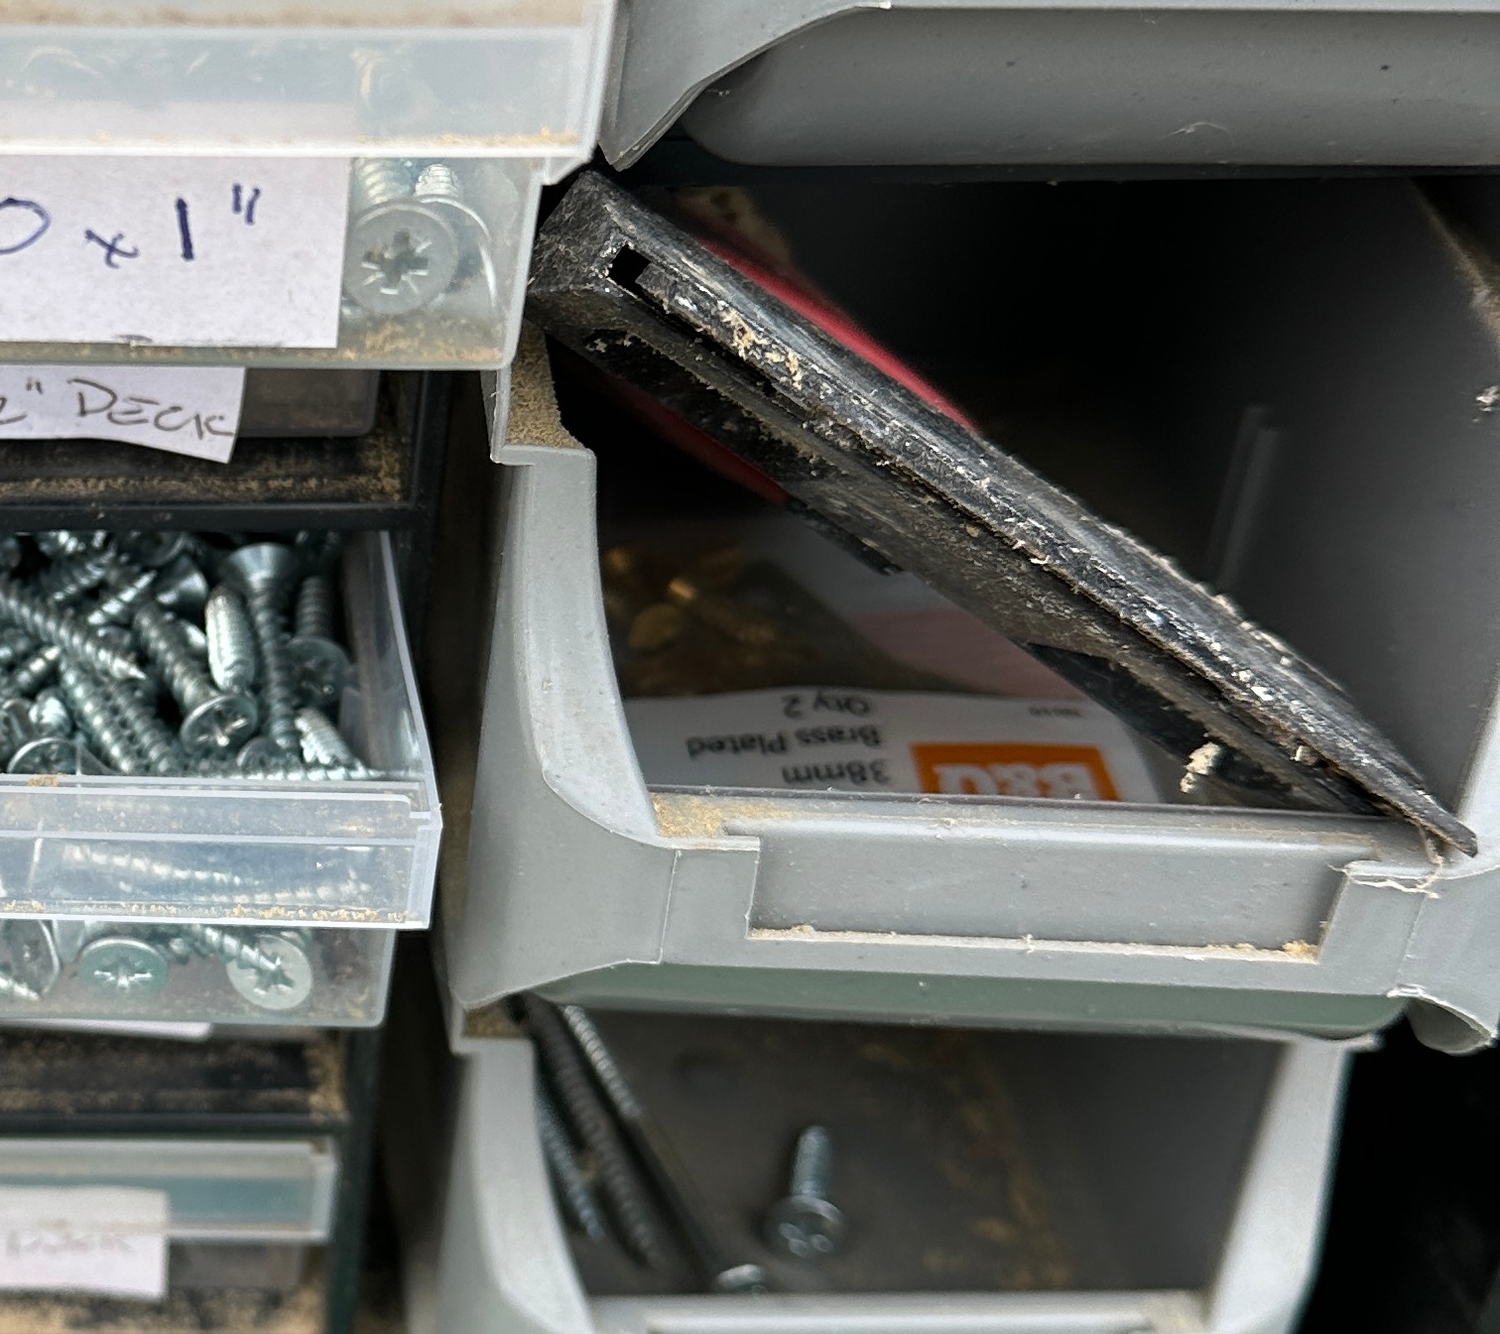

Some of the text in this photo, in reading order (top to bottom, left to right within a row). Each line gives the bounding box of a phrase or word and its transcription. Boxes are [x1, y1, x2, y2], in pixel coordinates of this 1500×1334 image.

[66, 377, 235, 441] DECK
[782, 690, 871, 719] Qty 2
[686, 725, 882, 759] Brass Plated
[781, 758, 892, 785] 38mm
